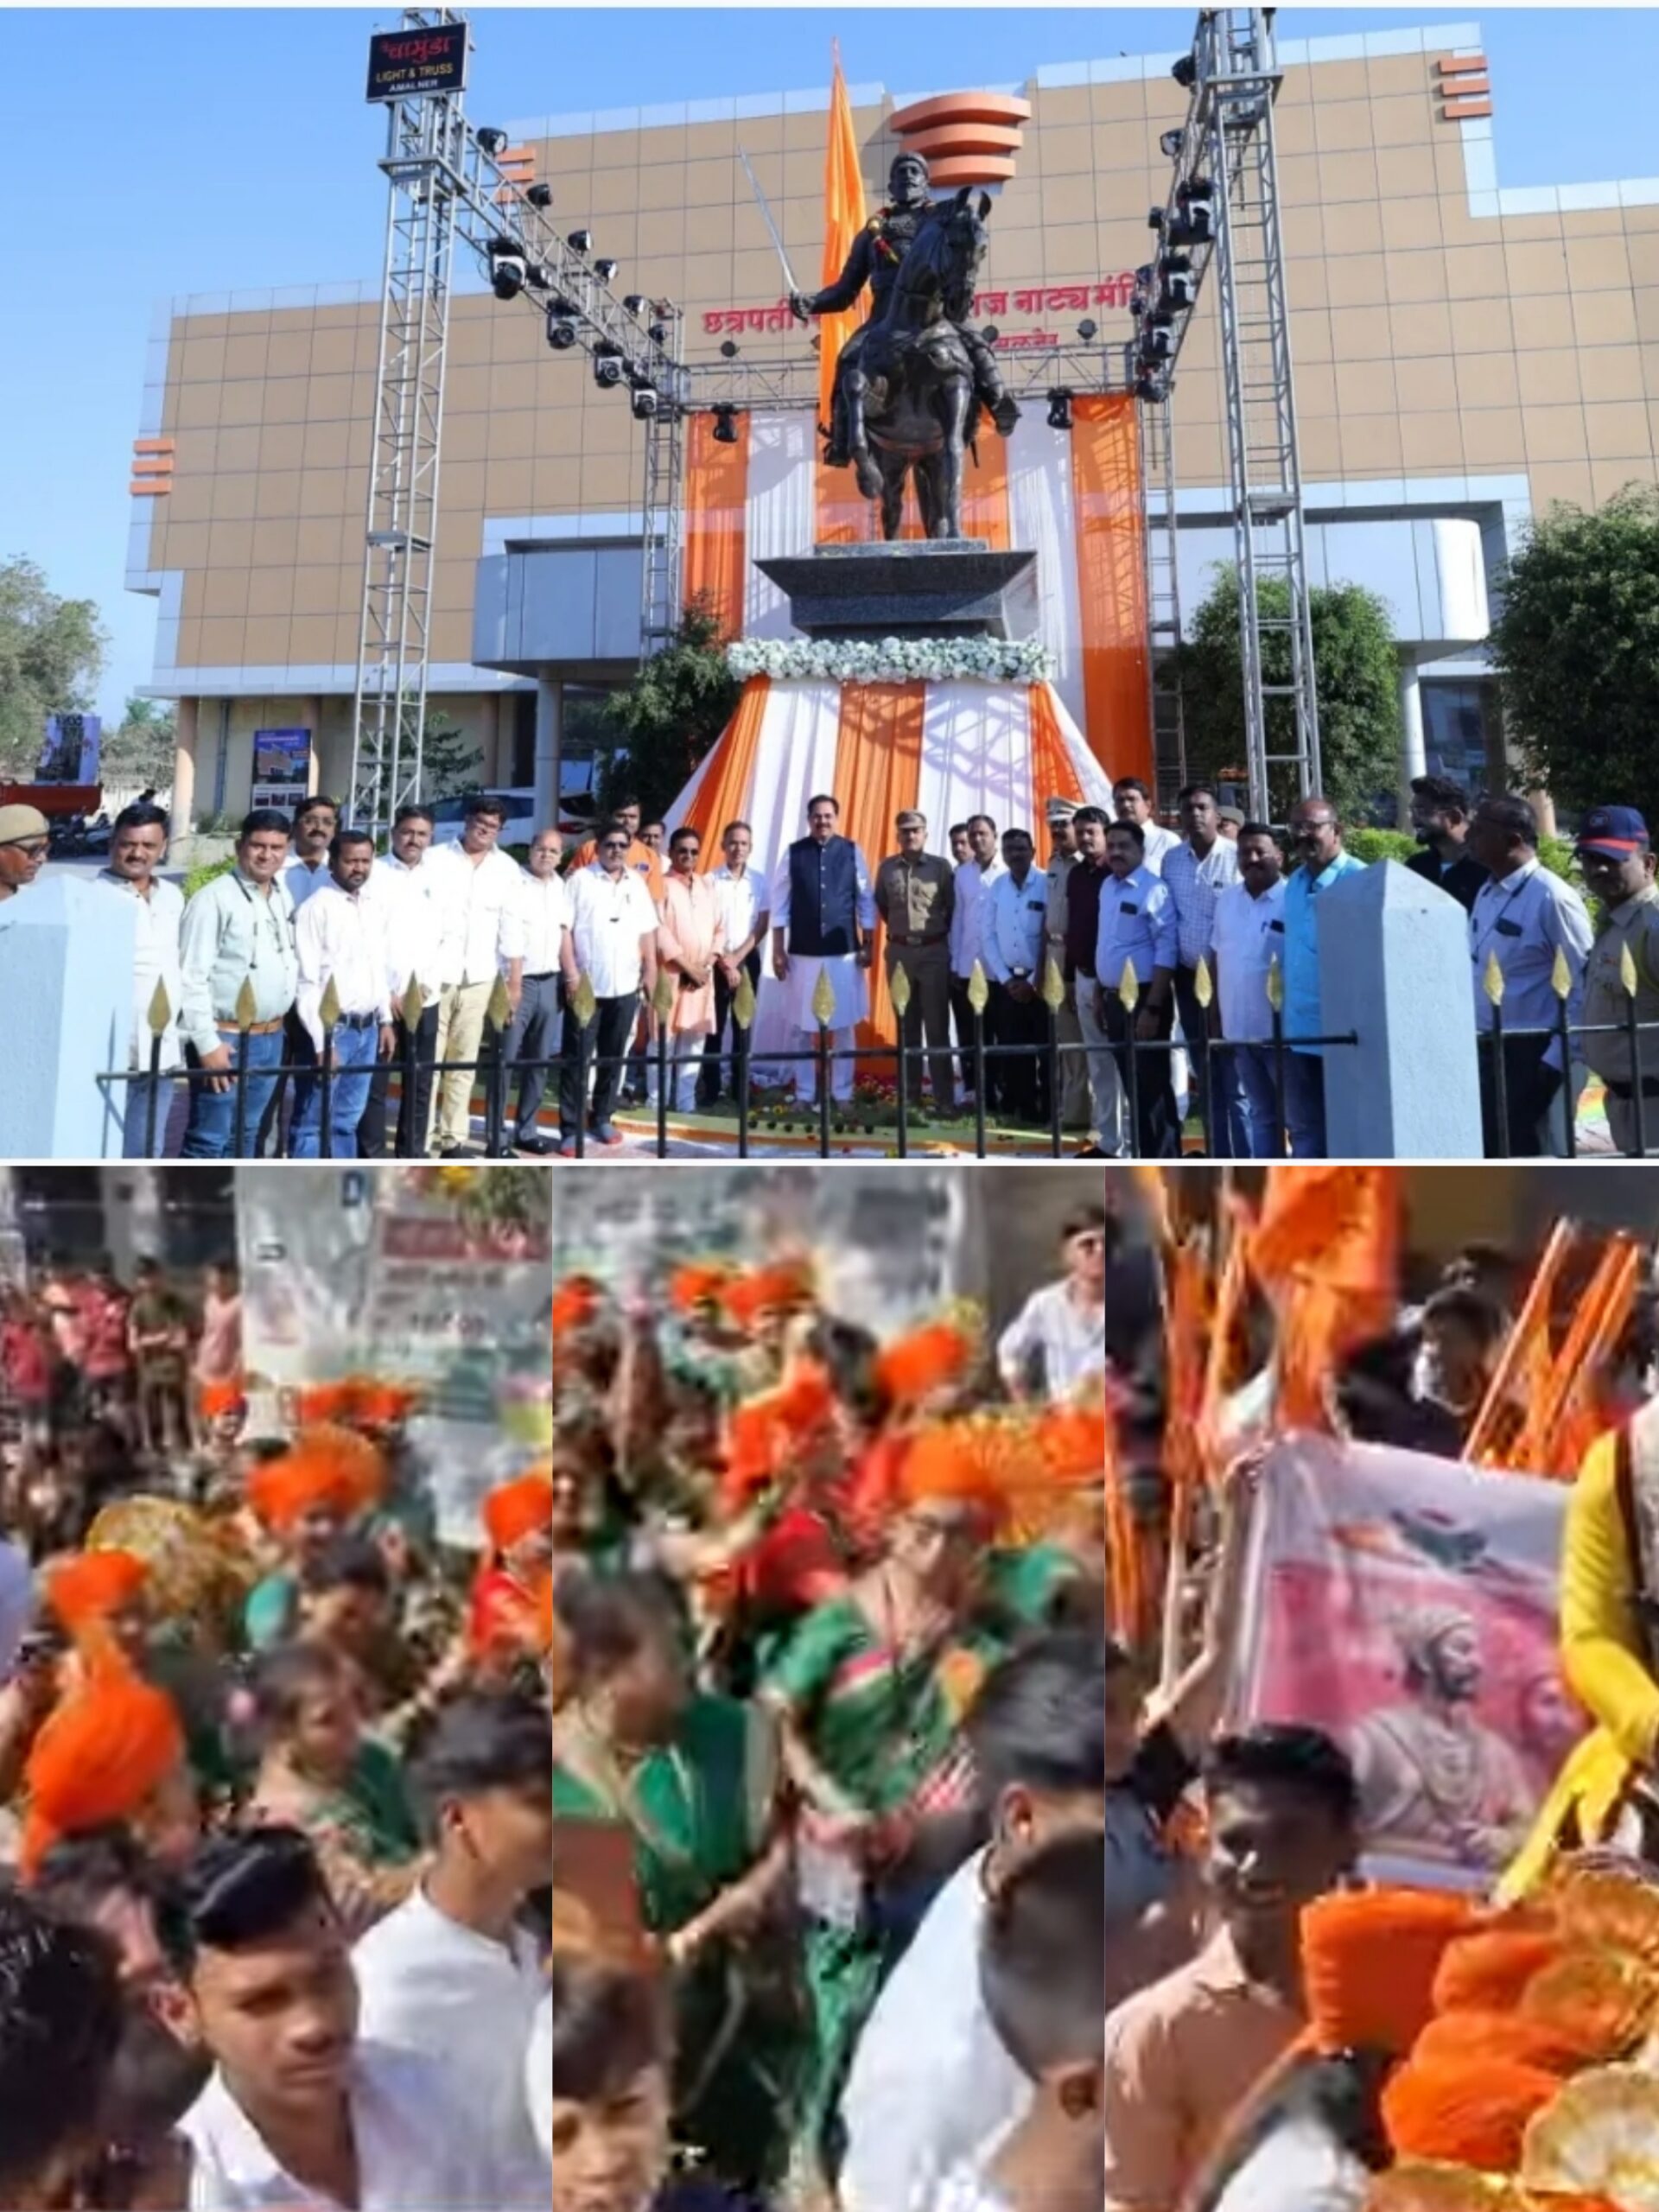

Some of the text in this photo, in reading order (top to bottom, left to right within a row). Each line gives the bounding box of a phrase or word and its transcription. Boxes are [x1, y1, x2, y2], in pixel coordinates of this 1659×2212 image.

[376, 62, 454, 83] LIGHT & TRUSS
